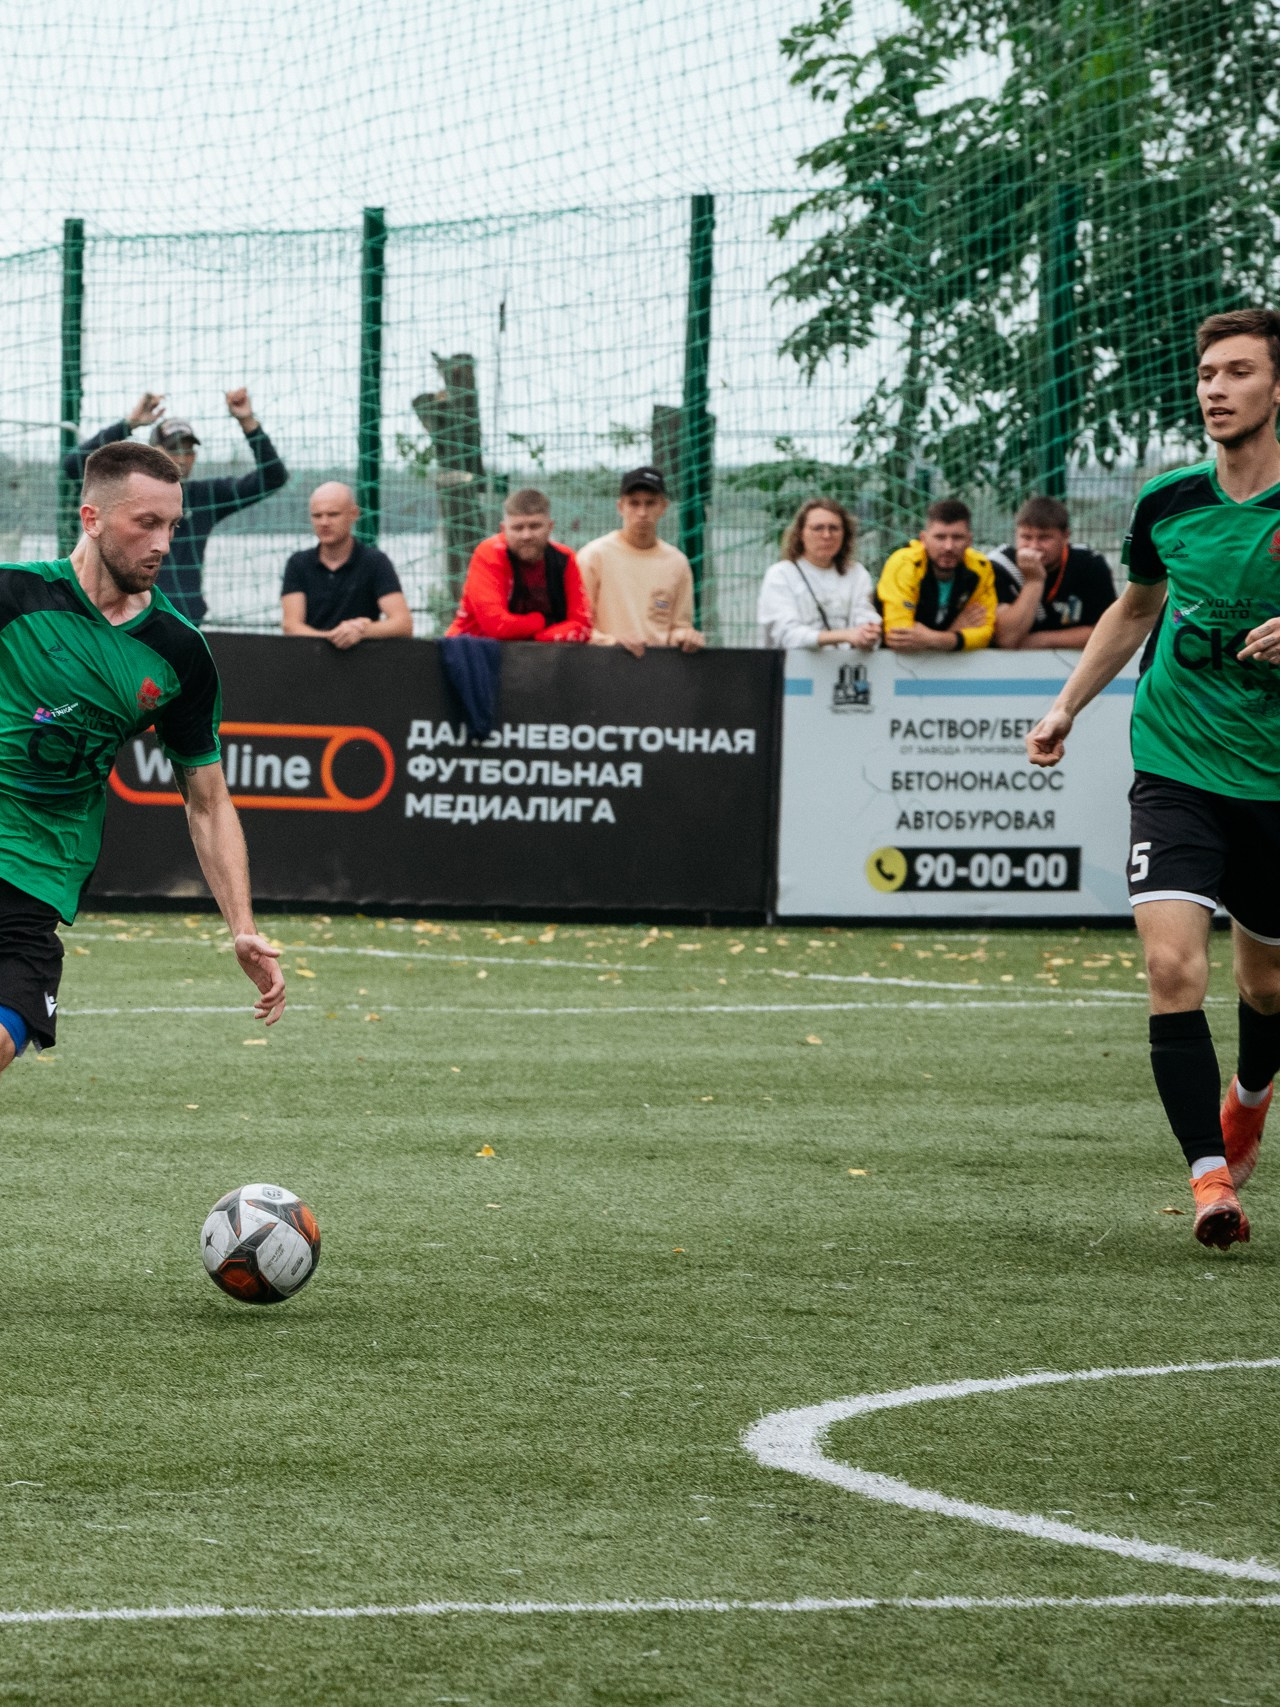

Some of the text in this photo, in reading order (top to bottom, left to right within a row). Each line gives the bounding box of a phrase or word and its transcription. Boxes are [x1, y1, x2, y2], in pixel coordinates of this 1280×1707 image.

[1206, 599, 1253, 608] VOLAT
[1209, 610, 1250, 619] AUTO
[133, 739, 311, 790] Wline
[406, 754, 644, 788] ФУТБОЛЬНАЯ
[891, 770, 1065, 792] БЕТОНОНАСОС
[405, 793, 616, 825] МЕДИАЛИГА
[896, 810, 1056, 831] АВТОБУРОВАЯ
[914, 853, 1068, 888] 90-00-00
[1129, 842, 1152, 883] 5
